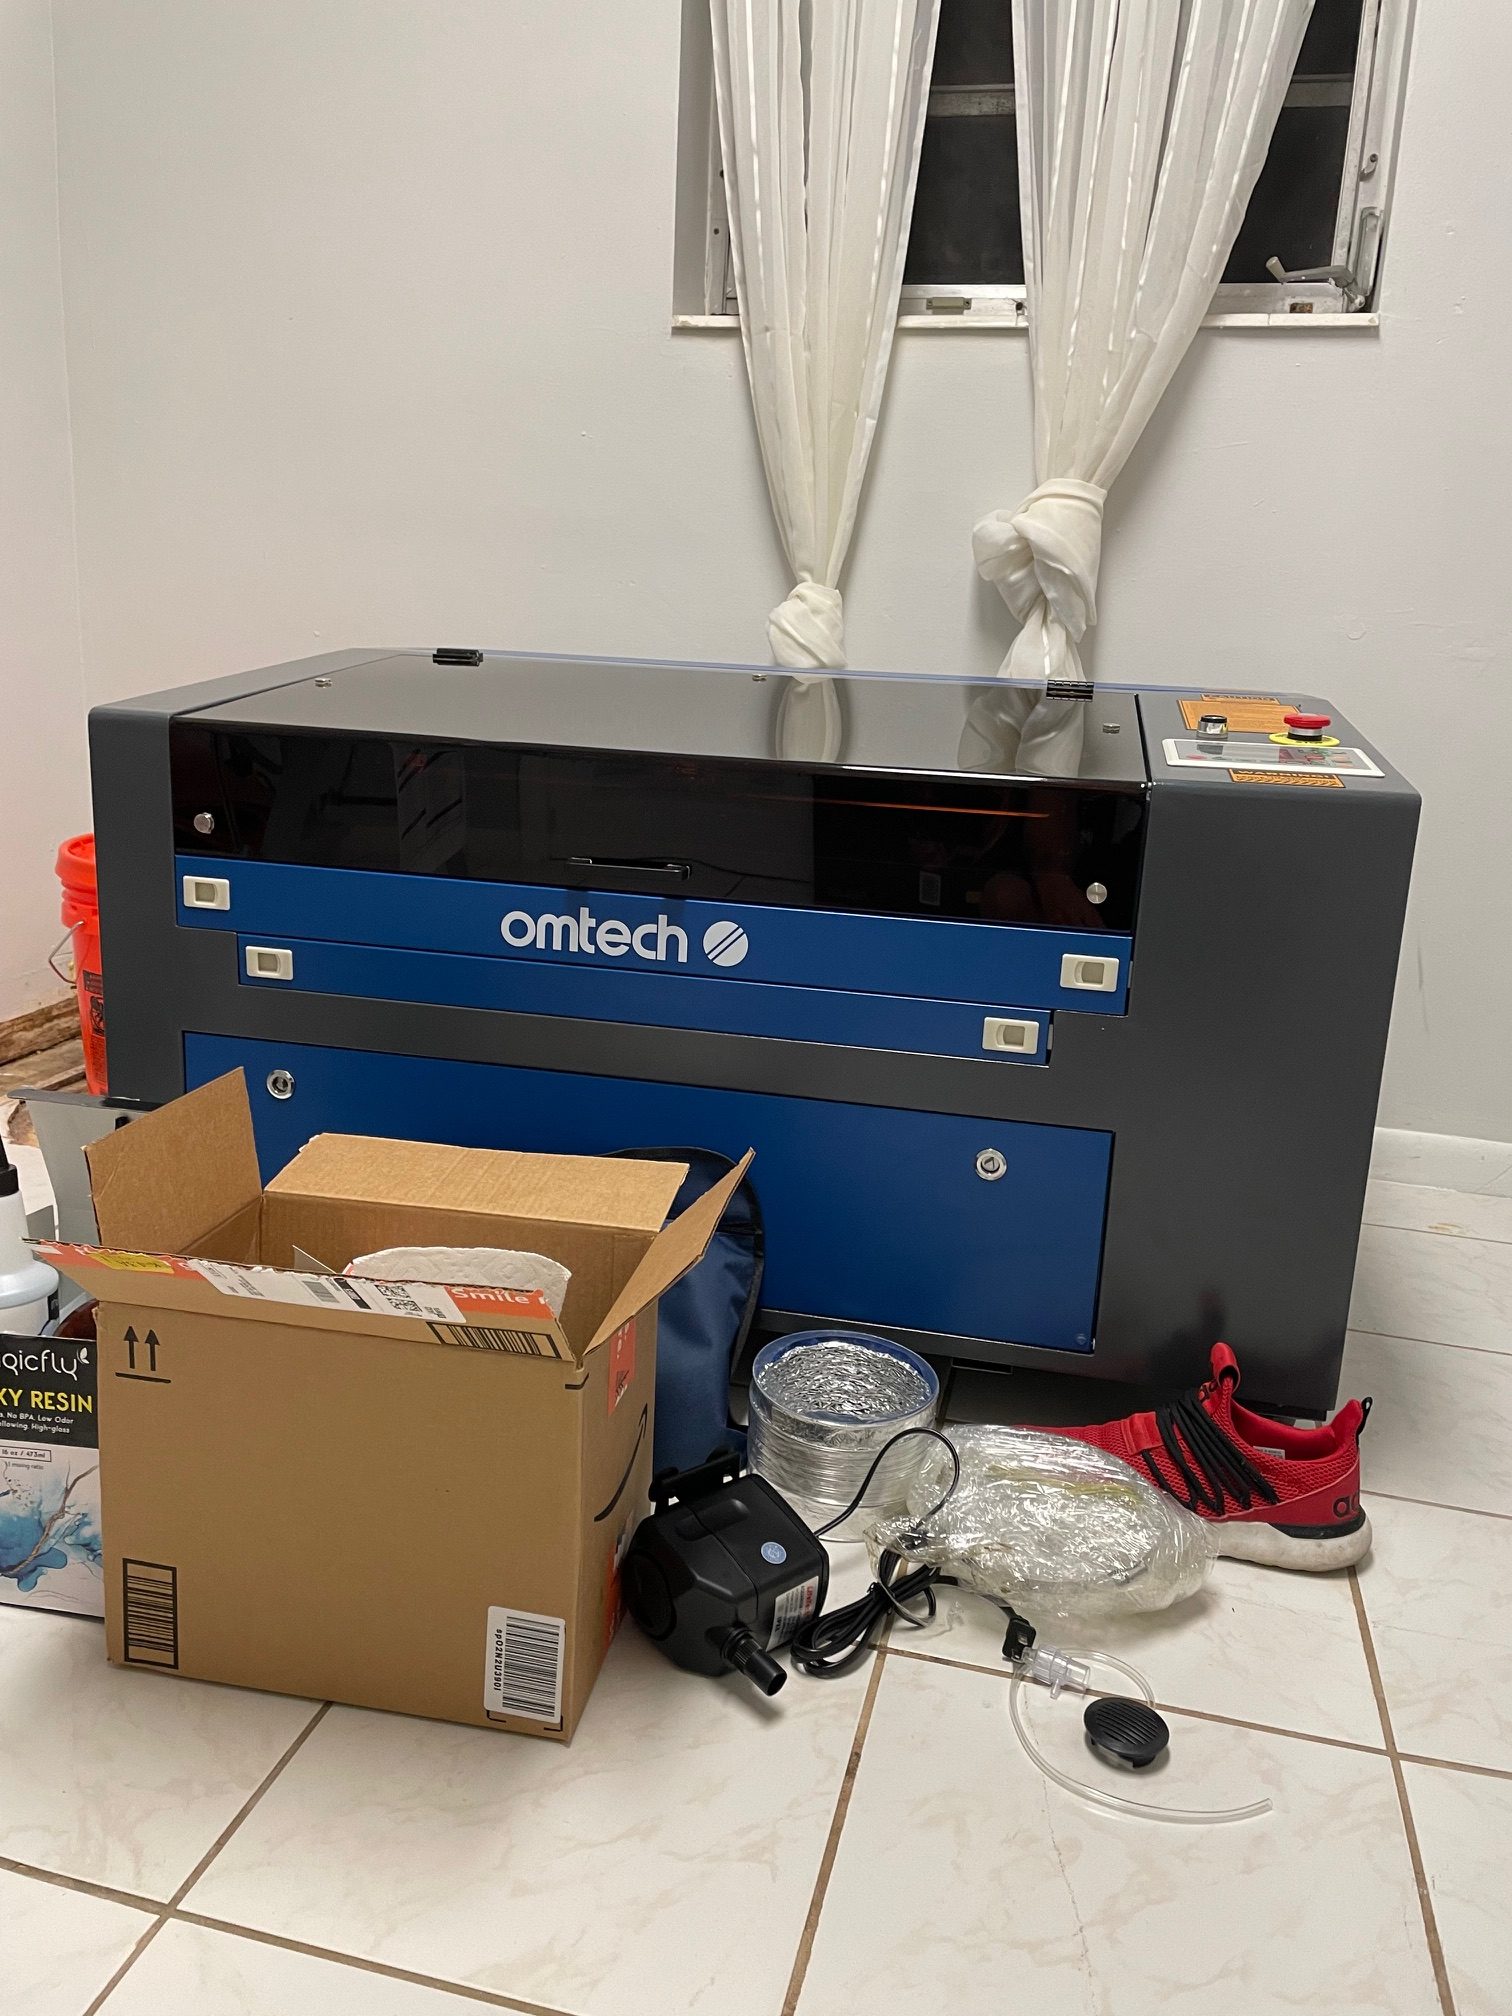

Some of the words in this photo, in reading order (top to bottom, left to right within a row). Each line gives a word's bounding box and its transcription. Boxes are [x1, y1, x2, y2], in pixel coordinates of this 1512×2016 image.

[500, 906, 688, 963] omtech
[451, 1288, 530, 1304] Smile
[0, 1349, 77, 1381] gicfly
[30, 1390, 93, 1414] RESIN
[37, 1414, 53, 1422] Low
[54, 1416, 74, 1424] Odor
